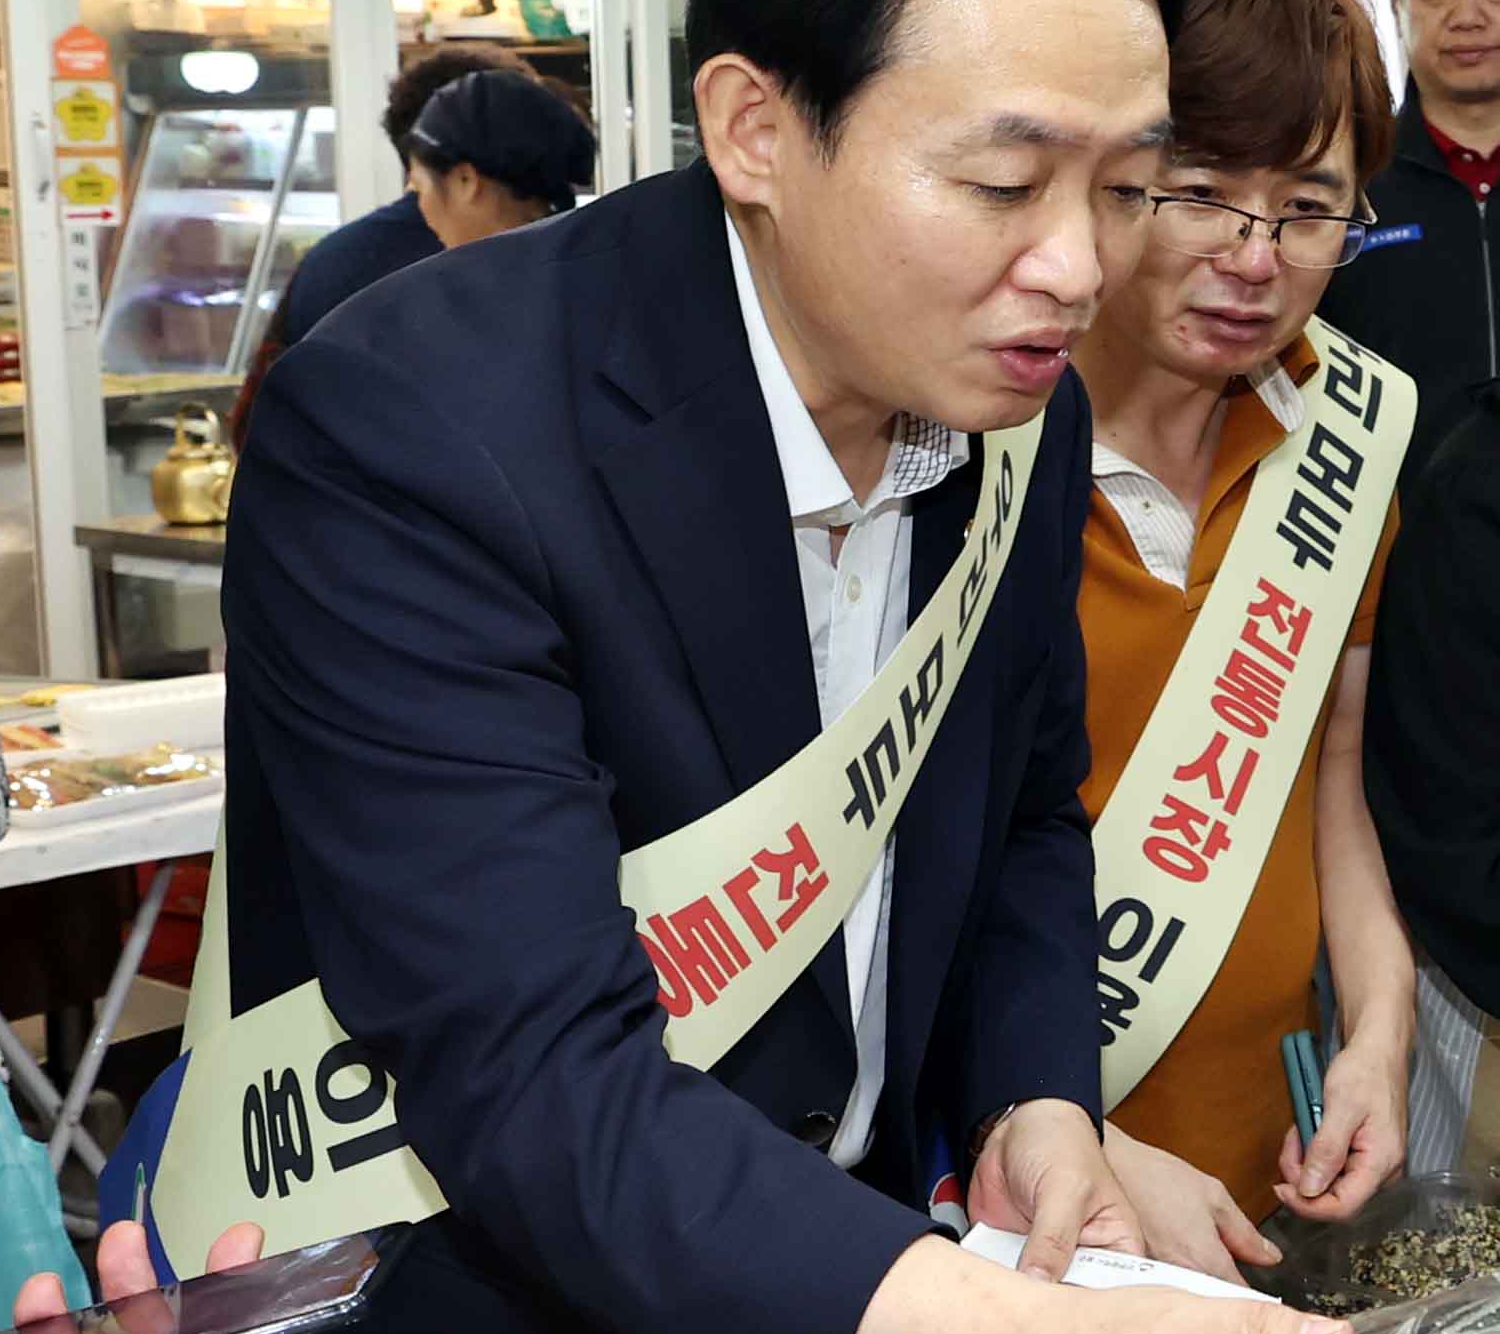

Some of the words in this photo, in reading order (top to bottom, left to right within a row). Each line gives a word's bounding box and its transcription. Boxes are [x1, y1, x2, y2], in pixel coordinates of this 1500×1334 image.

[957, 450, 1015, 648] 우리
[1276, 421, 1365, 572] 모두
[842, 634, 946, 830] 모두
[1142, 577, 1313, 883] 전통시장
[636, 822, 830, 1018] 전통
[242, 1038, 409, 1200] 이용
